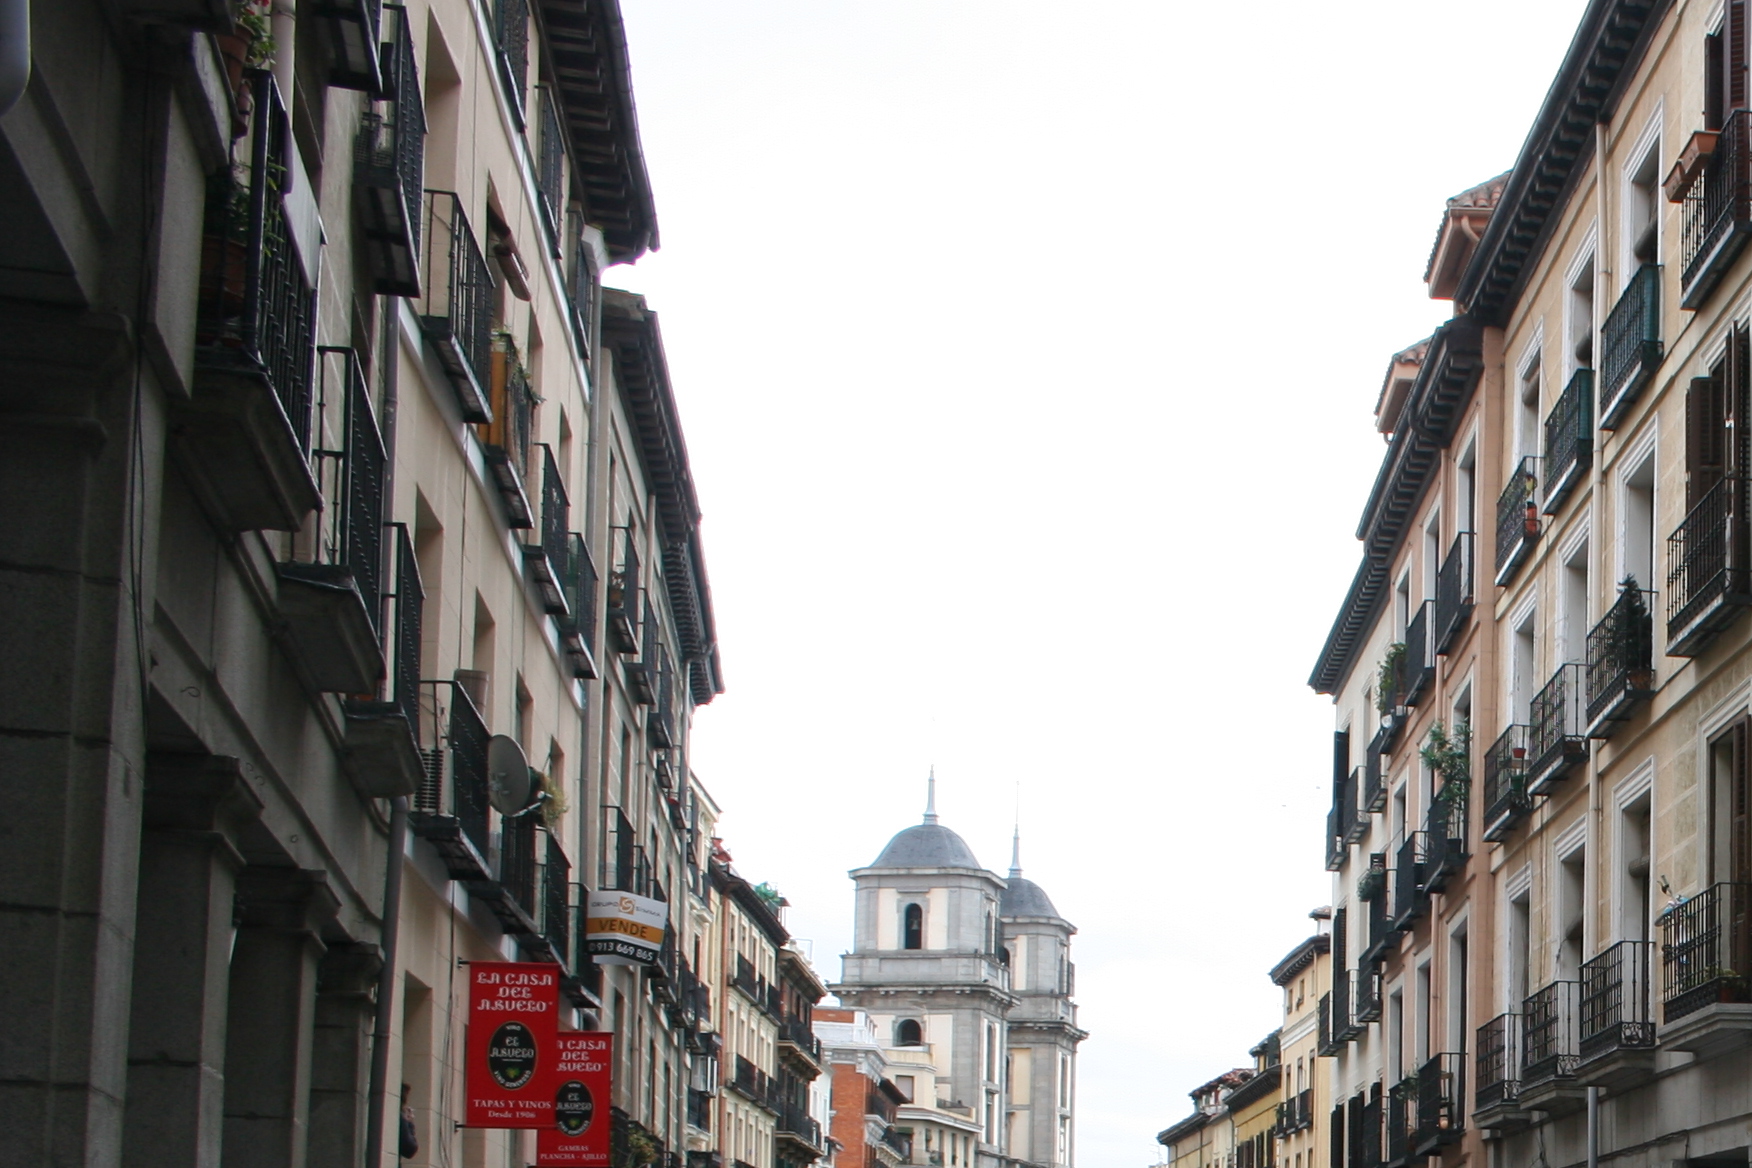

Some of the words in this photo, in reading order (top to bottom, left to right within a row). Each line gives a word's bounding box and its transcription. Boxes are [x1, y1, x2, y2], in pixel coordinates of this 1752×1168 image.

[599, 919, 648, 938] VENDE
[596, 942, 614, 951] 913
[616, 943, 635, 956] 669
[636, 949, 653, 961] 865
[476, 972, 500, 985] LA
[505, 973, 553, 986] CASA
[497, 986, 532, 998] DEL
[477, 999, 547, 1012] ABUELO
[505, 1036, 520, 1047] EL
[567, 1040, 606, 1050] CASA
[490, 1047, 535, 1058] ABUELO
[561, 1050, 590, 1061] DEL
[556, 1062, 602, 1072] BUELO
[473, 1098, 505, 1108] TAPAS
[508, 1100, 517, 1108] Y
[519, 1100, 552, 1109] VINOS
[488, 1110, 513, 1118] Desde
